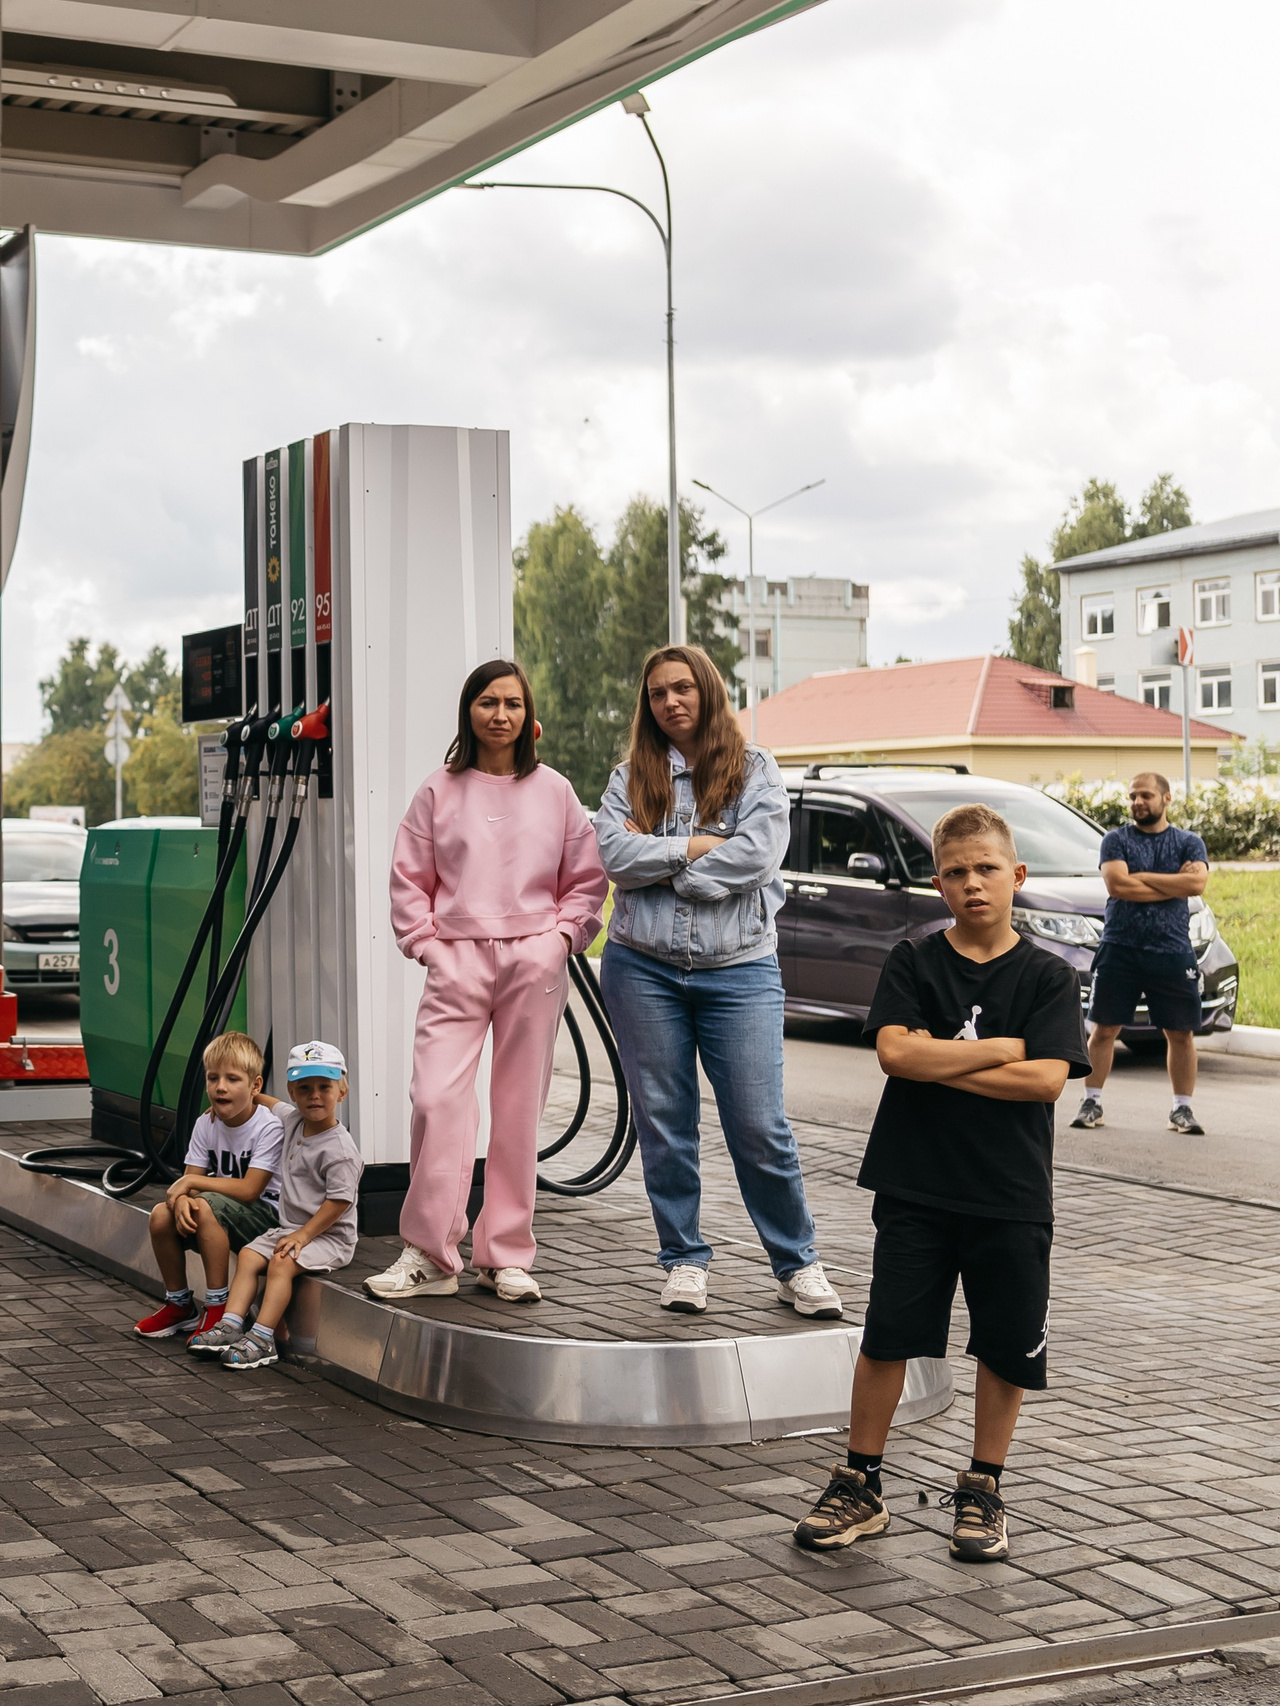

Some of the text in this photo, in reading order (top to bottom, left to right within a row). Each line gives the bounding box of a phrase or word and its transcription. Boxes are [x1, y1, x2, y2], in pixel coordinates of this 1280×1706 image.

[267, 603, 281, 628] ДТ
[291, 597, 305, 622] 92
[315, 592, 330, 617] 95
[245, 607, 258, 631] ДТ
[43, 955, 80, 968] А257
[103, 928, 120, 996] 3
